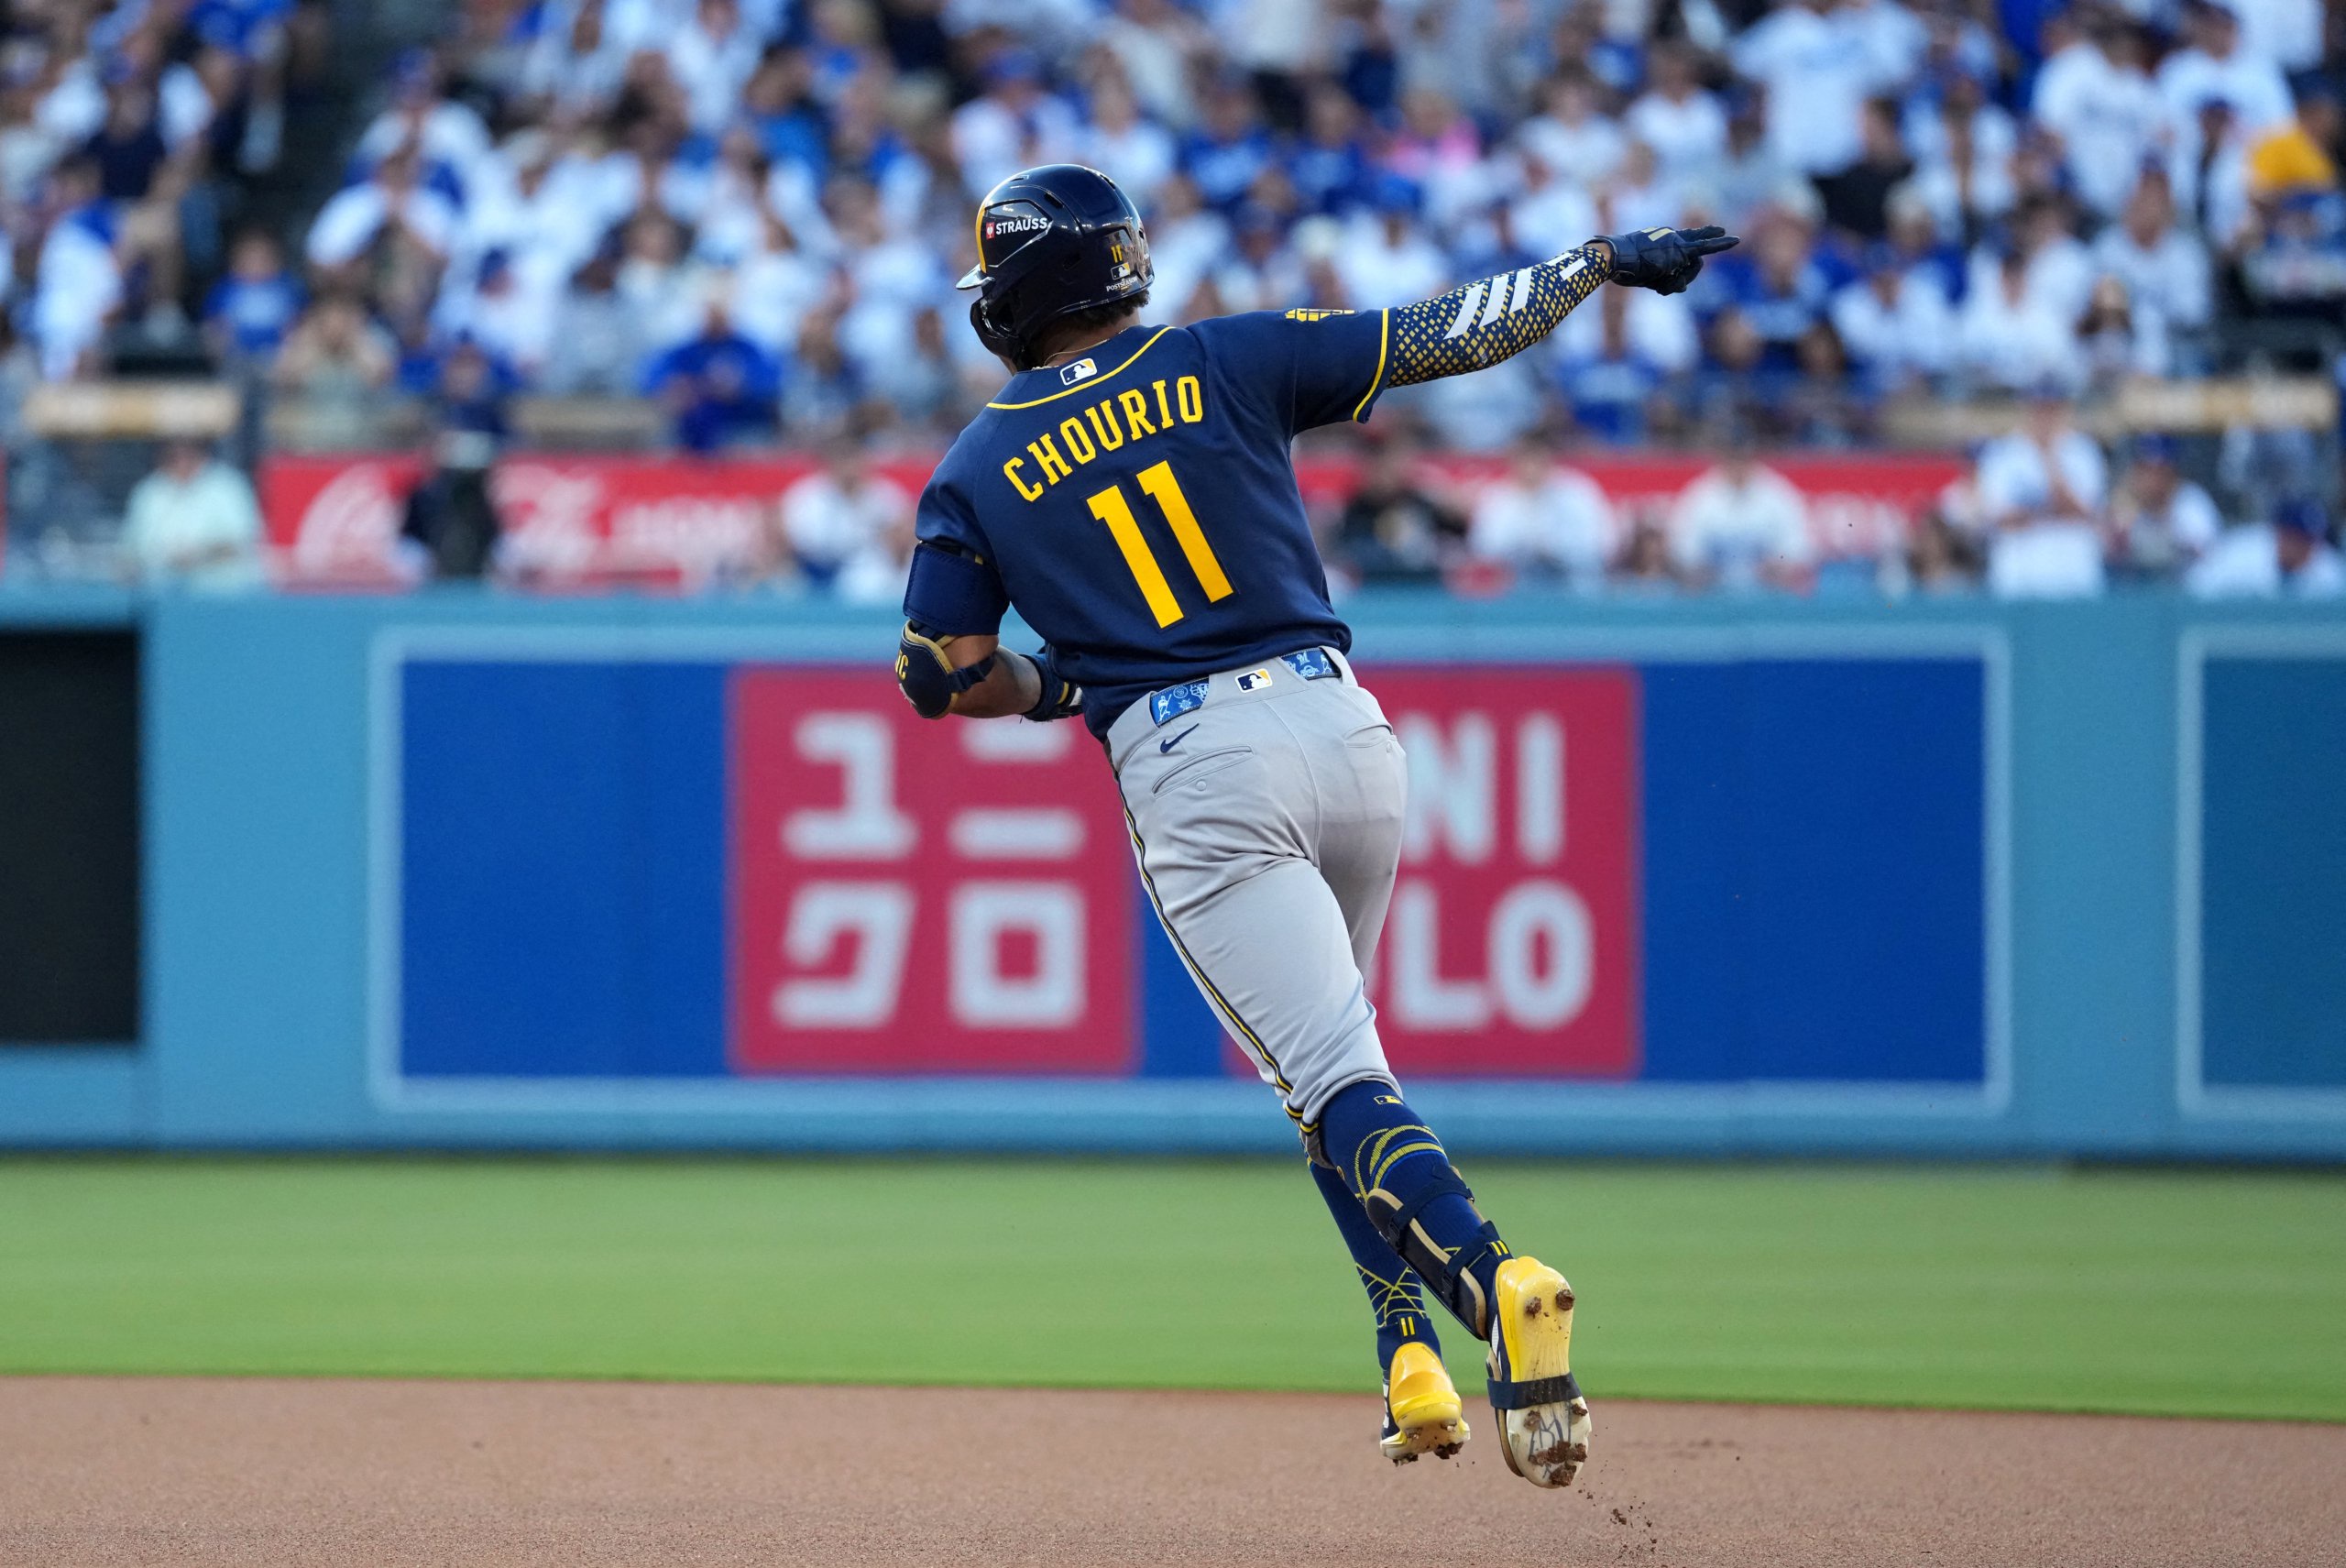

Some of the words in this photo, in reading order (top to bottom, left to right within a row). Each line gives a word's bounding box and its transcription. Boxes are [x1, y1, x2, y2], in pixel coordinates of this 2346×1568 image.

[995, 217, 1047, 235] STRAUSS
[1106, 276, 1137, 291] POSTSEASON
[1111, 244, 1123, 263] 11
[1003, 376, 1203, 501] CHOURIO
[1086, 460, 1234, 629] 11
[1398, 710, 1565, 865] NI
[1390, 878, 1595, 1030] LO
